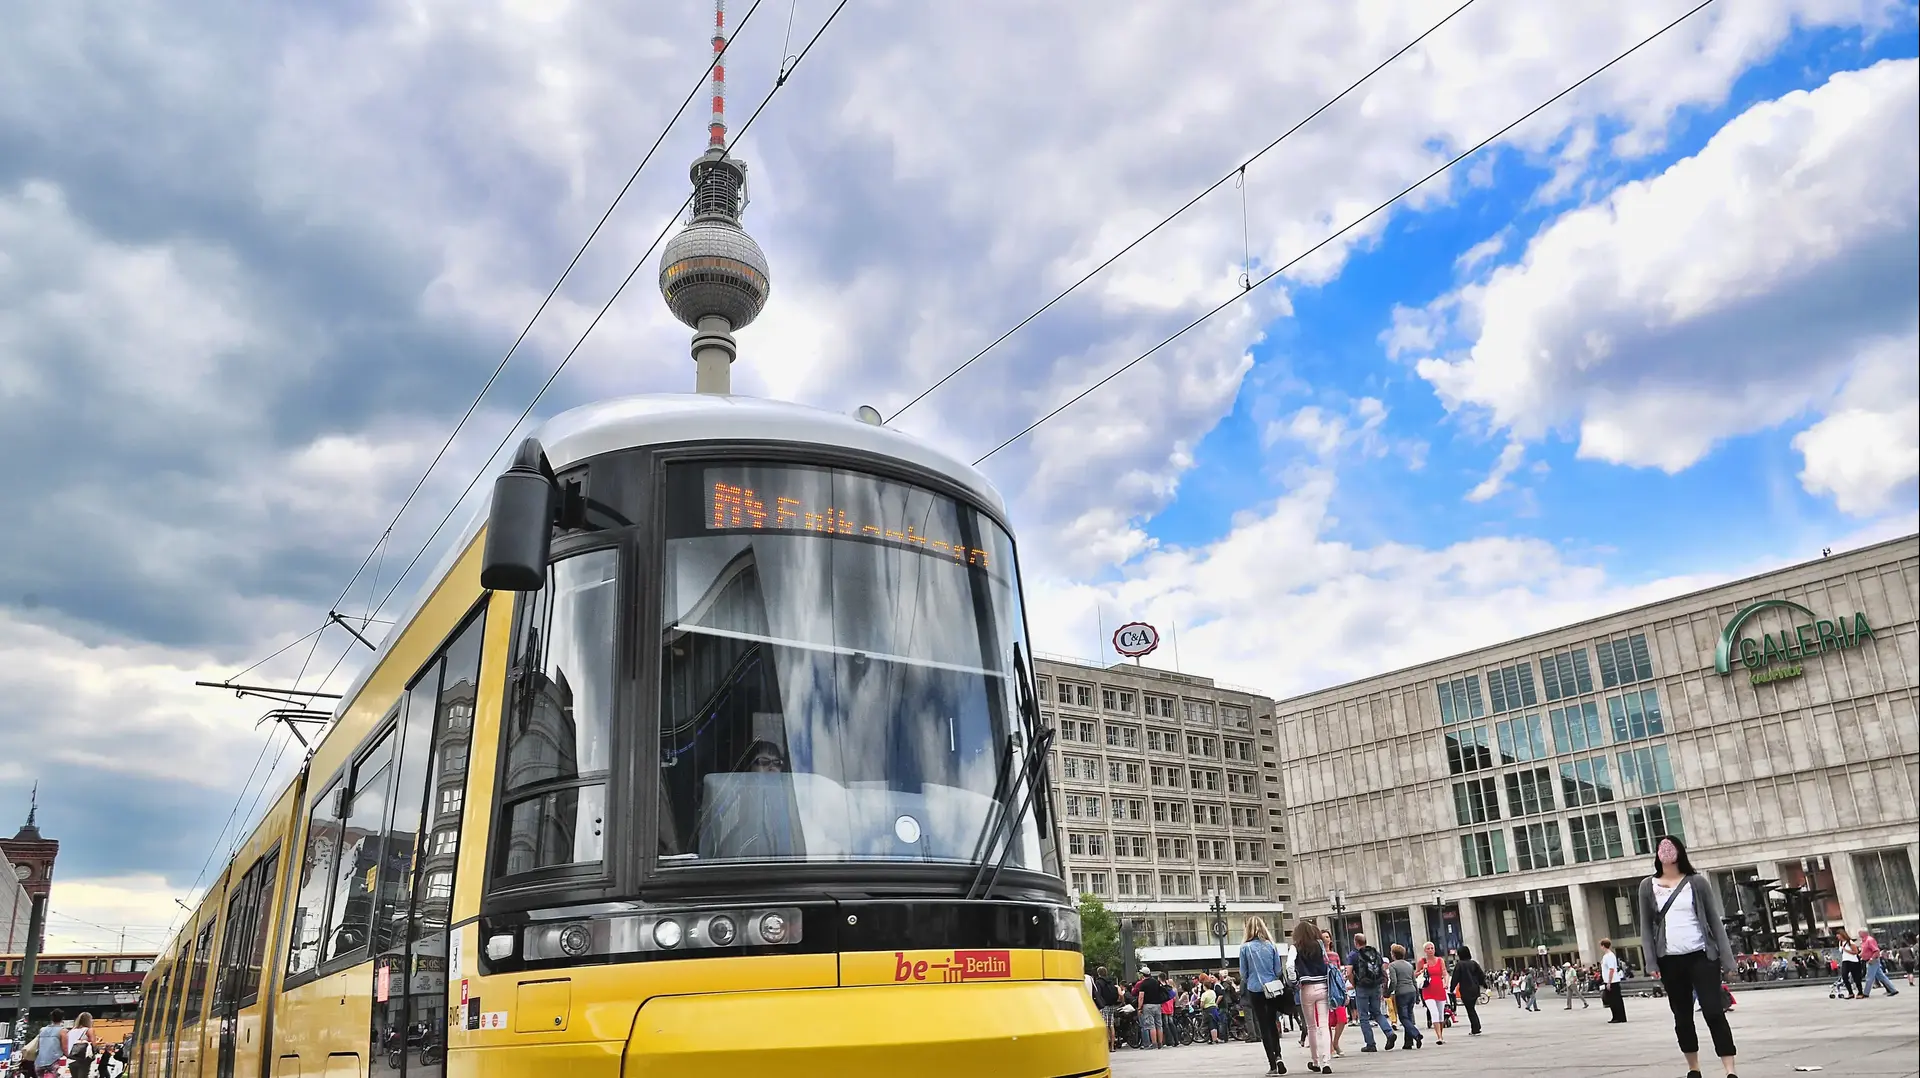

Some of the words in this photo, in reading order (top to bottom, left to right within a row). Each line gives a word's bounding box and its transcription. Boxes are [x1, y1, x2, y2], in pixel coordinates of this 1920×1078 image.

[1120, 629, 1151, 647] C&A
[1738, 611, 1878, 670] GALERIA
[894, 951, 929, 982] be
[966, 956, 1007, 974] Berlin
